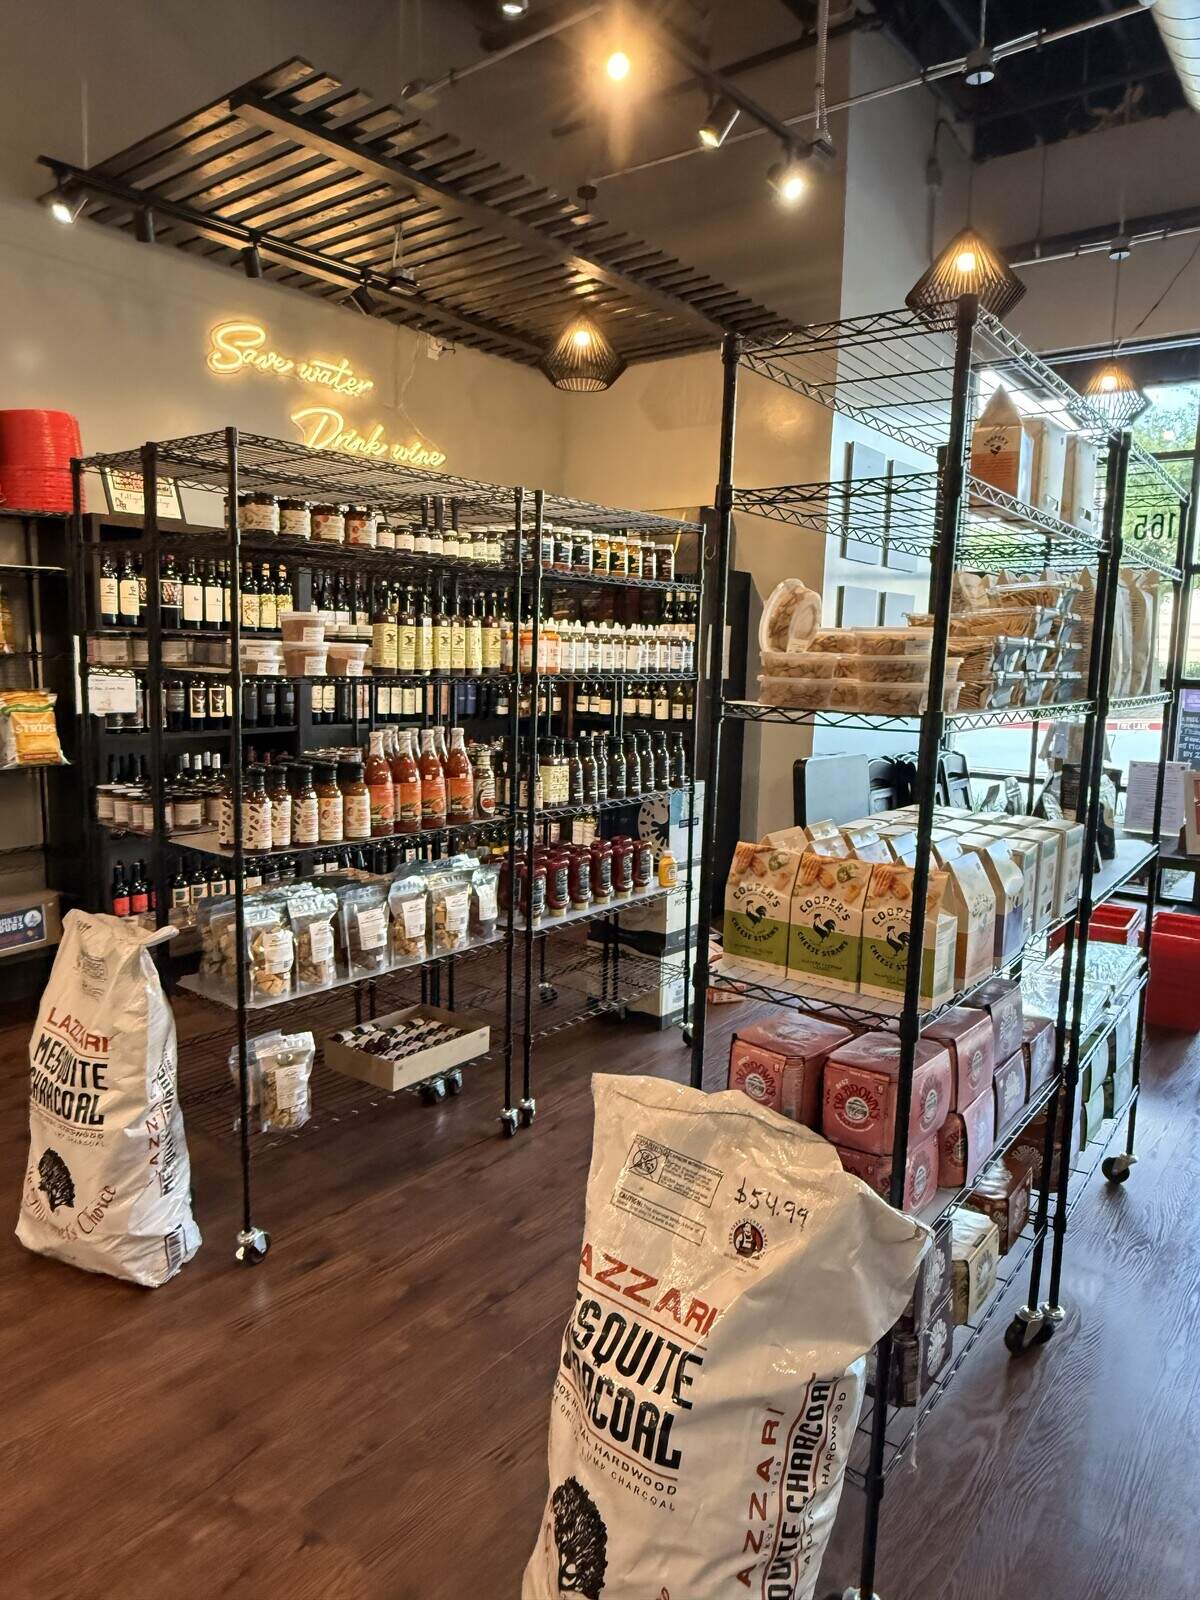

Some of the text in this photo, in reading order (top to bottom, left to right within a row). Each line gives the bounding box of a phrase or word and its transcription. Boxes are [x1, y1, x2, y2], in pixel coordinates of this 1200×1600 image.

[208, 321, 374, 397] Save water
[290, 406, 446, 469] Drink wine
[732, 882, 781, 908] COOPER'S
[799, 895, 851, 921] COOPER'S
[871, 906, 912, 925] COOPE
[77, 1184, 116, 1234] Choice
[734, 1176, 810, 1233] $54.99
[580, 1242, 719, 1336] AZZARI
[572, 1291, 704, 1411] SQUITE
[594, 1441, 678, 1496] HARDWOOD
[821, 1391, 847, 1486] HARDWOOD
[611, 1470, 676, 1512] CHARCOAL
[736, 1407, 785, 1588] AZZARI
[767, 1521, 801, 1600] QUITE
